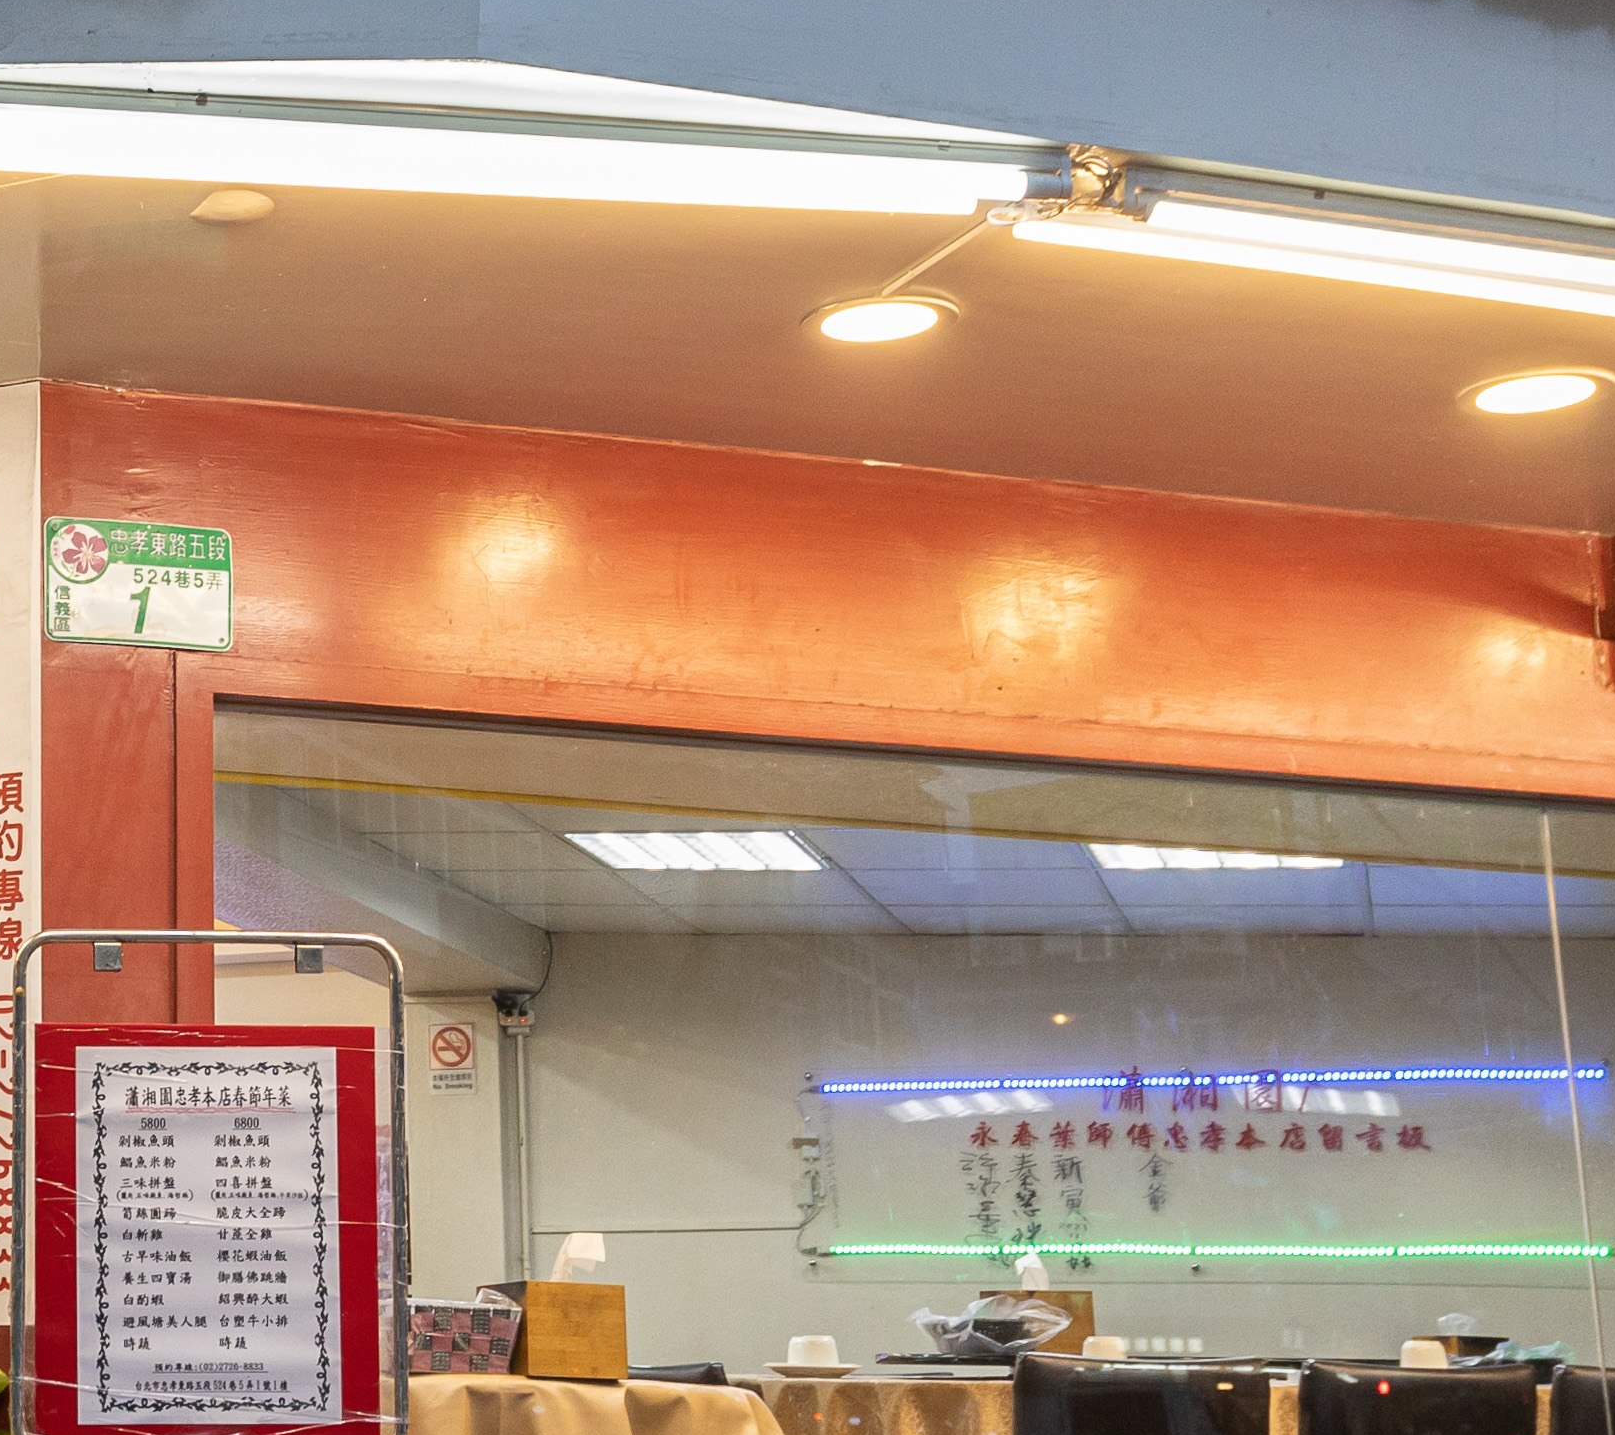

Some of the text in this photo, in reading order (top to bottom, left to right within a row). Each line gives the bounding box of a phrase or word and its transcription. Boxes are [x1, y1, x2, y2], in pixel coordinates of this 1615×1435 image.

[109, 528, 227, 561] 忠孝東路五段
[133, 568, 223, 591] 524巷5弄
[53, 585, 71, 632] 信義區
[129, 586, 151, 634] 1
[140, 1118, 166, 1129] 5800
[234, 1118, 259, 1129] 6800
[118, 1134, 174, 1148] 剁椒魚頭
[213, 1134, 270, 1148] 剁椒魚頭
[120, 1177, 176, 1190] 三味拼盤
[215, 1177, 273, 1190] 四喜拼盤
[122, 1228, 163, 1241] 白斬雞
[121, 1250, 192, 1263] 古早味油飯
[217, 1249, 288, 1263] 櫻花蝦油飯
[121, 1271, 192, 1285] 養生四寶湯
[218, 1292, 289, 1306] 紹興醉大蝦
[219, 1314, 289, 1328] 台塑牛小排
